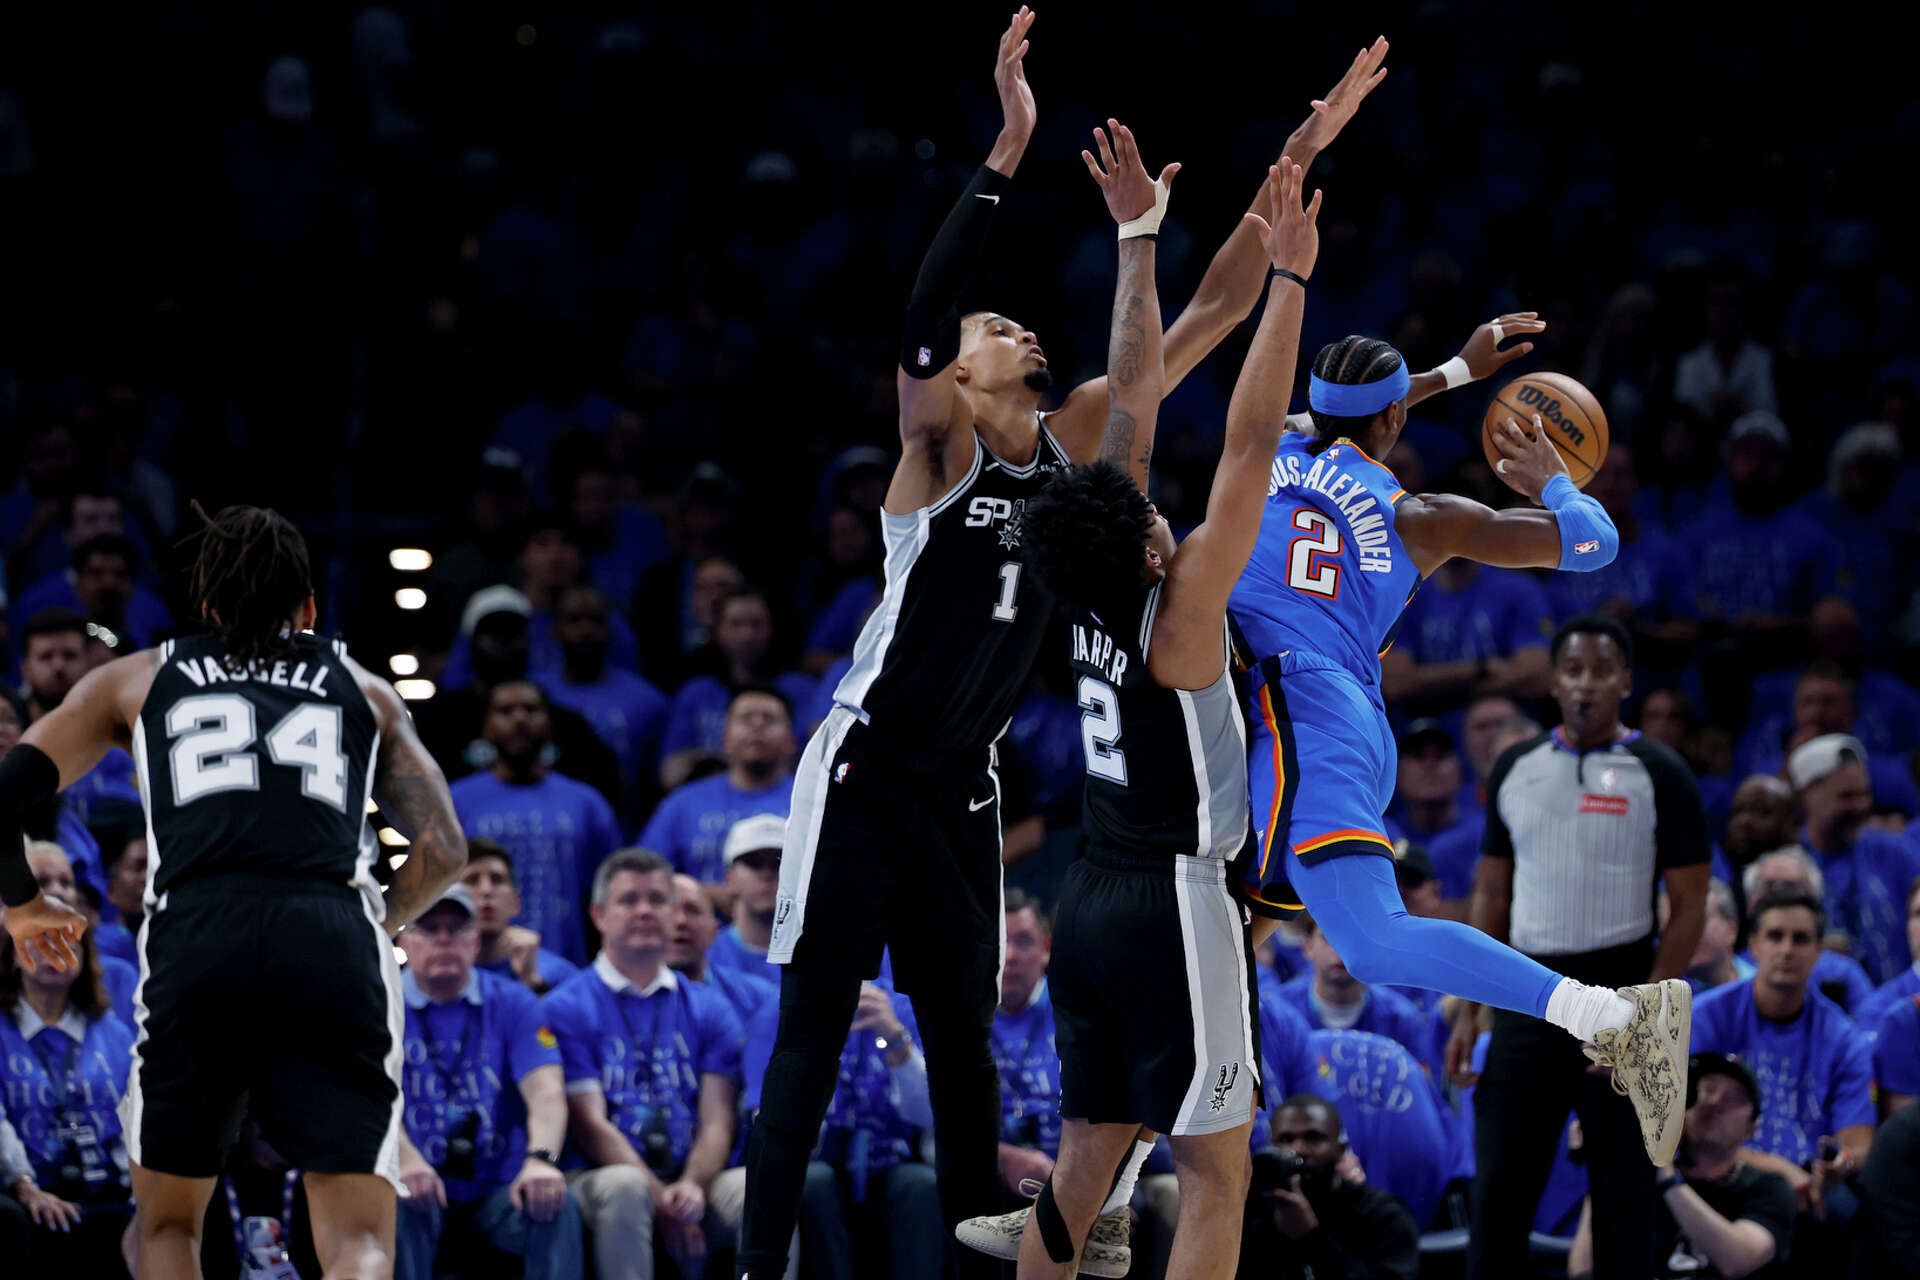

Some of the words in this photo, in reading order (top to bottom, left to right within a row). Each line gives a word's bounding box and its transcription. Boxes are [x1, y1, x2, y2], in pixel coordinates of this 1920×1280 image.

[1516, 385, 1585, 447] Wilson
[991, 561, 1022, 623] 1
[1286, 507, 1343, 601] 2
[1073, 624, 1128, 687] ARPR
[164, 692, 350, 815] 24
[1078, 674, 1128, 787] 2
